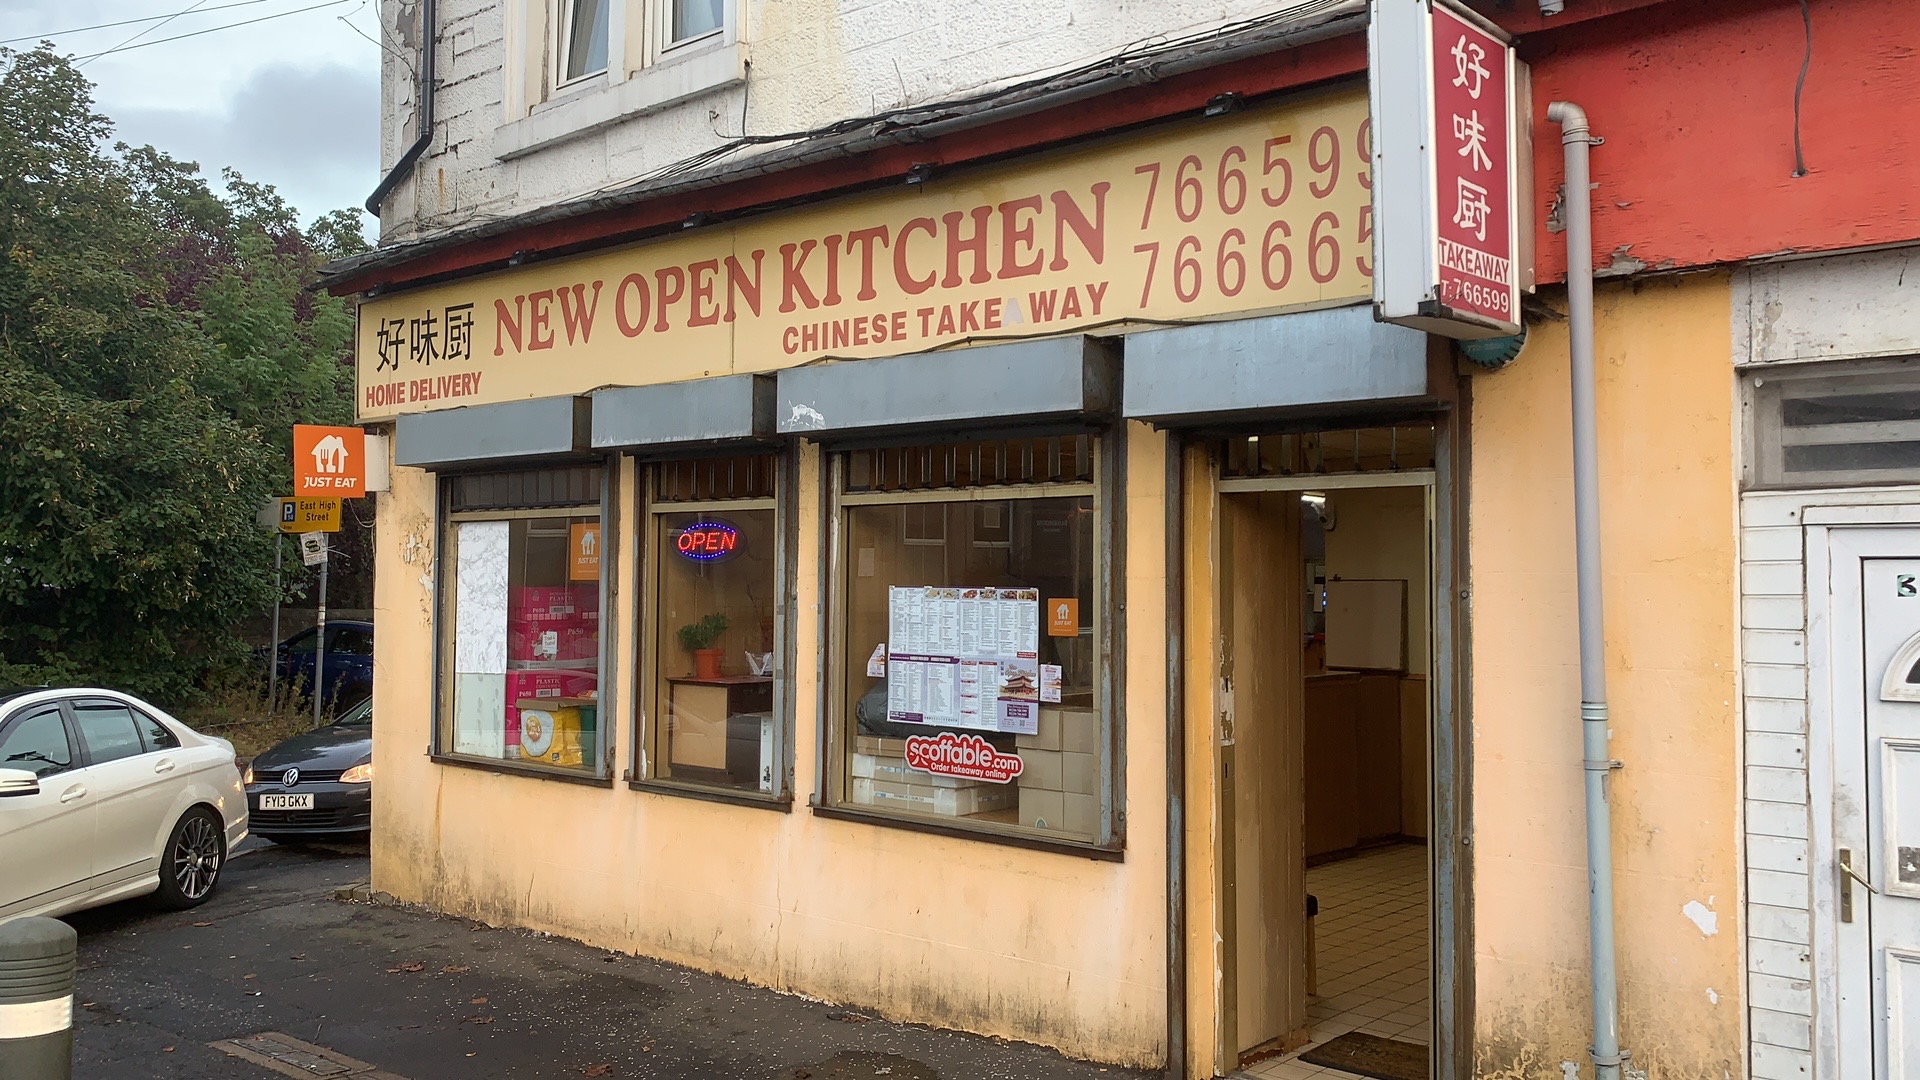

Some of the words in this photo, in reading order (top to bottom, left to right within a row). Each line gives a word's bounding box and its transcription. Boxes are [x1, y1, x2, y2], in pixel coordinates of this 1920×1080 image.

[1450, 33, 1493, 242] 好味厨
[493, 279, 604, 357] NEW
[614, 248, 766, 339] OPEN
[778, 180, 1112, 314] KITCHEN
[1438, 238, 1510, 284] TAKEAWAY
[376, 302, 475, 373] 好味厨
[782, 310, 908, 356] CHINESE
[365, 381, 406, 409] HOME
[409, 370, 483, 403] DELIVERY
[303, 476, 333, 489] JUST
[334, 477, 357, 488] EAT
[300, 501, 316, 510] East
[320, 501, 336, 511] High
[306, 512, 329, 521] Street
[678, 532, 736, 550] OPEN
[577, 557, 589, 565] JUST
[909, 738, 1019, 772] scoffable.com
[931, 762, 950, 772] Order
[951, 764, 984, 778] takeaway
[985, 769, 1007, 779] online
[265, 796, 286, 808] FY13
[288, 795, 307, 807] GKX
